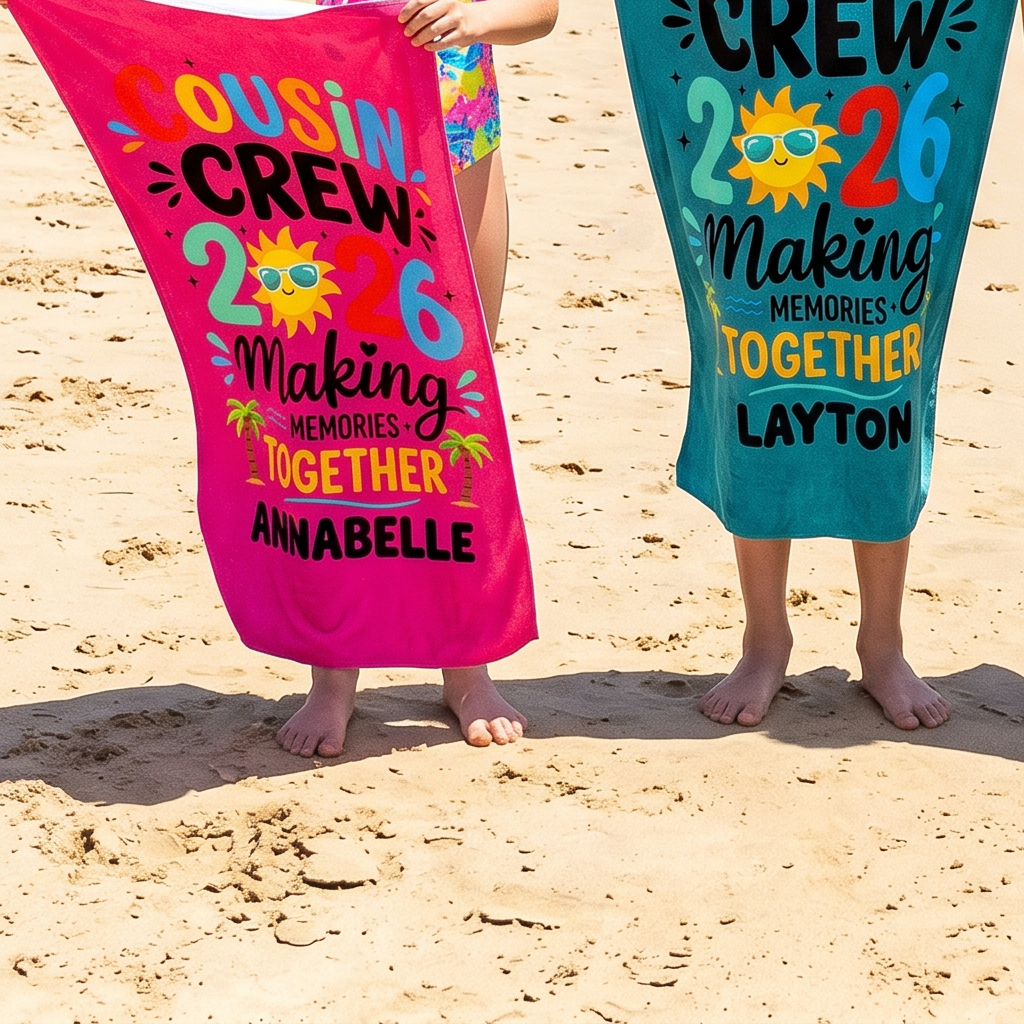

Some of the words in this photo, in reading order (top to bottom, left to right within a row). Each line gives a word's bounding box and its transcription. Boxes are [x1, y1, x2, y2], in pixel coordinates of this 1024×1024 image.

[180, 142, 413, 247] CREW
[704, 202, 934, 314] Making
[770, 294, 887, 326] MEMORIES
[234, 329, 464, 442] Making
[720, 327, 922, 383] TOGETHER
[290, 411, 400, 442] MEMORIES
[736, 399, 912, 451] LAYTON
[263, 433, 449, 496] TOGETHER
[250, 501, 476, 563] ANNABELLE
